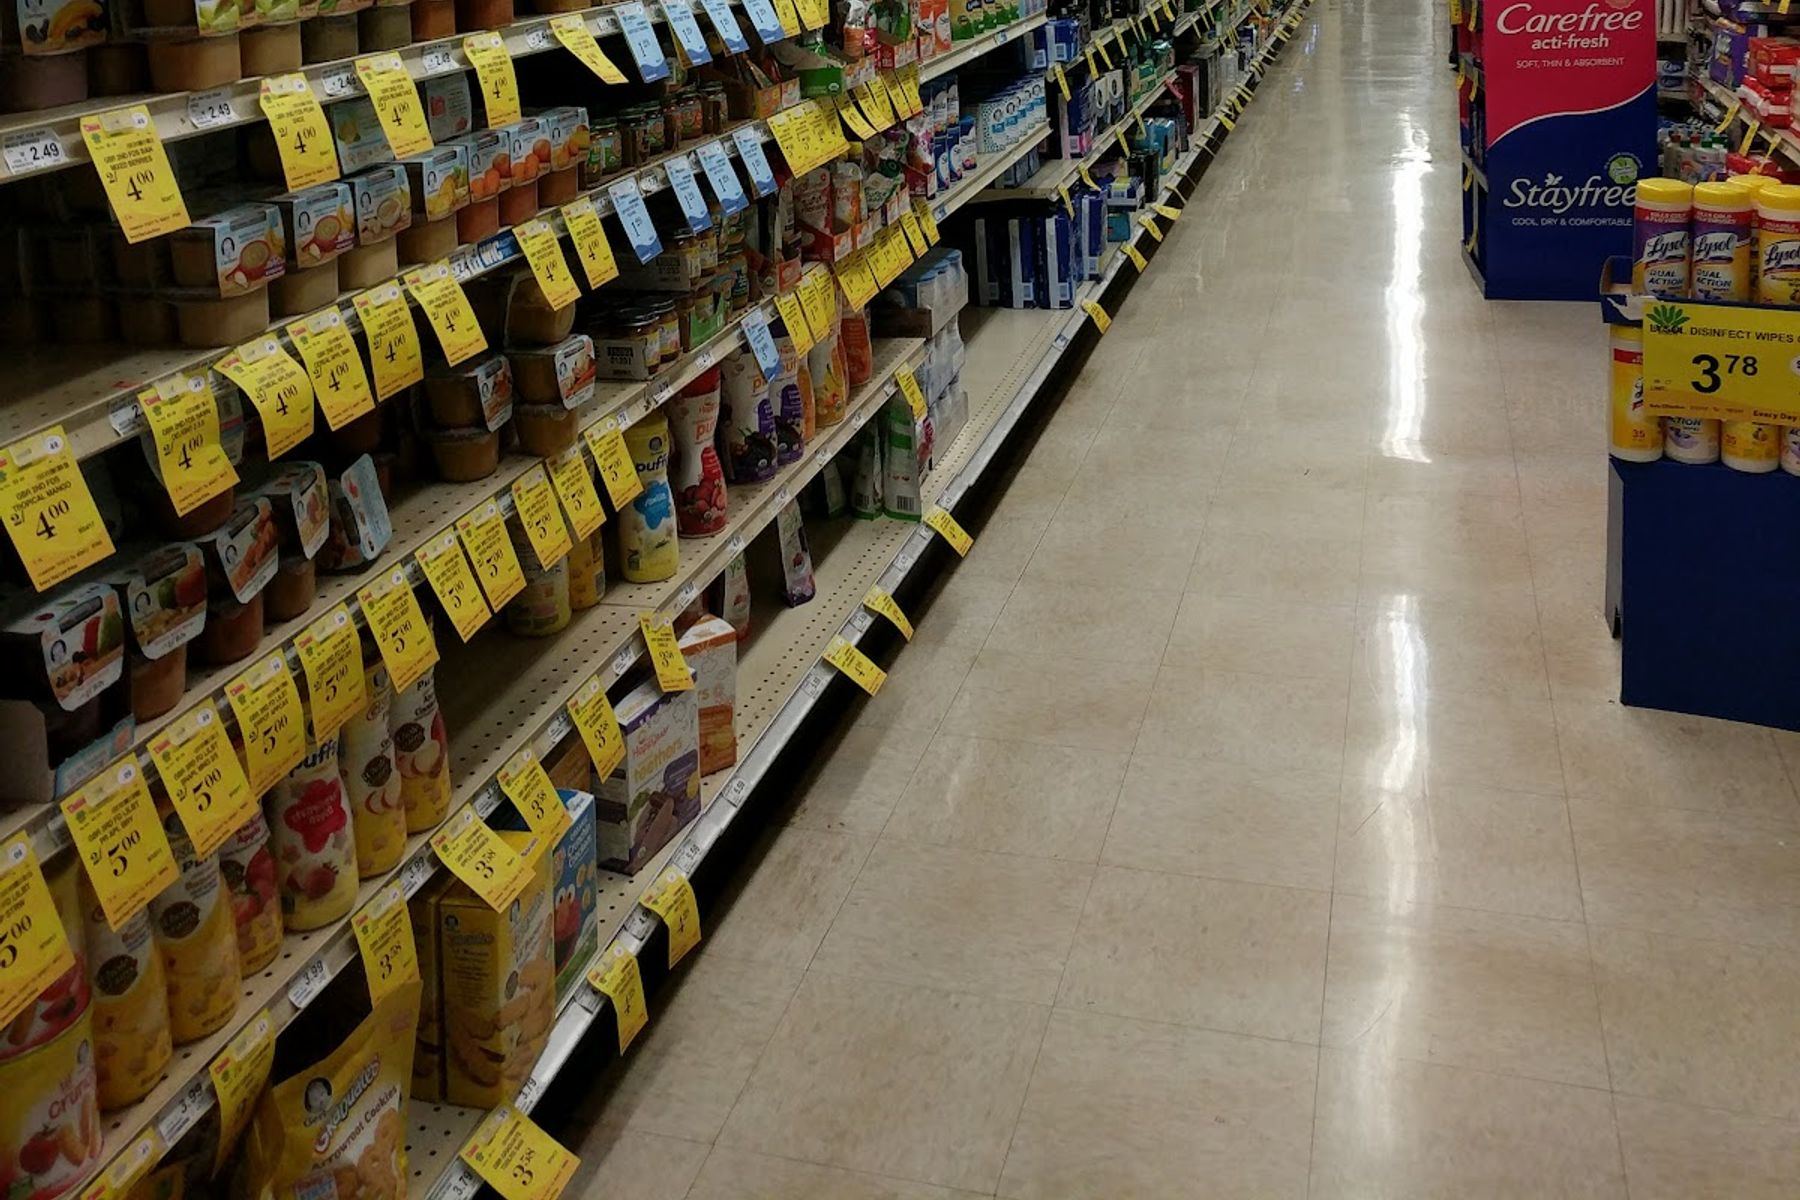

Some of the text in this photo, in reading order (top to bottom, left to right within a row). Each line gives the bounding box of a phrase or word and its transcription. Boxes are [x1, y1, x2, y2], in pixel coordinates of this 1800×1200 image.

[1496, 2, 1643, 36] Carefree
[1531, 33, 1610, 51] acti-fresh
[1516, 57, 1624, 70] SOFT, THIN & ABSORBENT
[208, 103, 232, 120] 2.49
[30, 141, 60, 162] 2.49
[1503, 175, 1638, 214] Stayfree
[1512, 216, 1633, 227] COOL, DRY & COMFORTABLE
[1647, 232, 1688, 258] Lysol
[1694, 234, 1734, 258] Lysol
[1649, 277, 1684, 286] ACTION
[1650, 269, 1676, 277] DUAL
[1696, 270, 1721, 278] DUAL
[1696, 277, 1732, 287] ACTION
[1690, 326, 1751, 341] DISINFECT
[1755, 332, 1794, 344] WIPES
[1667, 416, 1702, 426] CTION
[1753, 410, 1798, 422] Every Day
[12, 481, 72, 513] TROPICAL MANGO
[302, 960, 323, 987] 3.99
[521, 1078, 537, 1099] 3.79
[314, 1054, 381, 1154] Graduates
[311, 1084, 398, 1171] Arrowroot Cookies
[452, 1171, 473, 1196] 3.79
